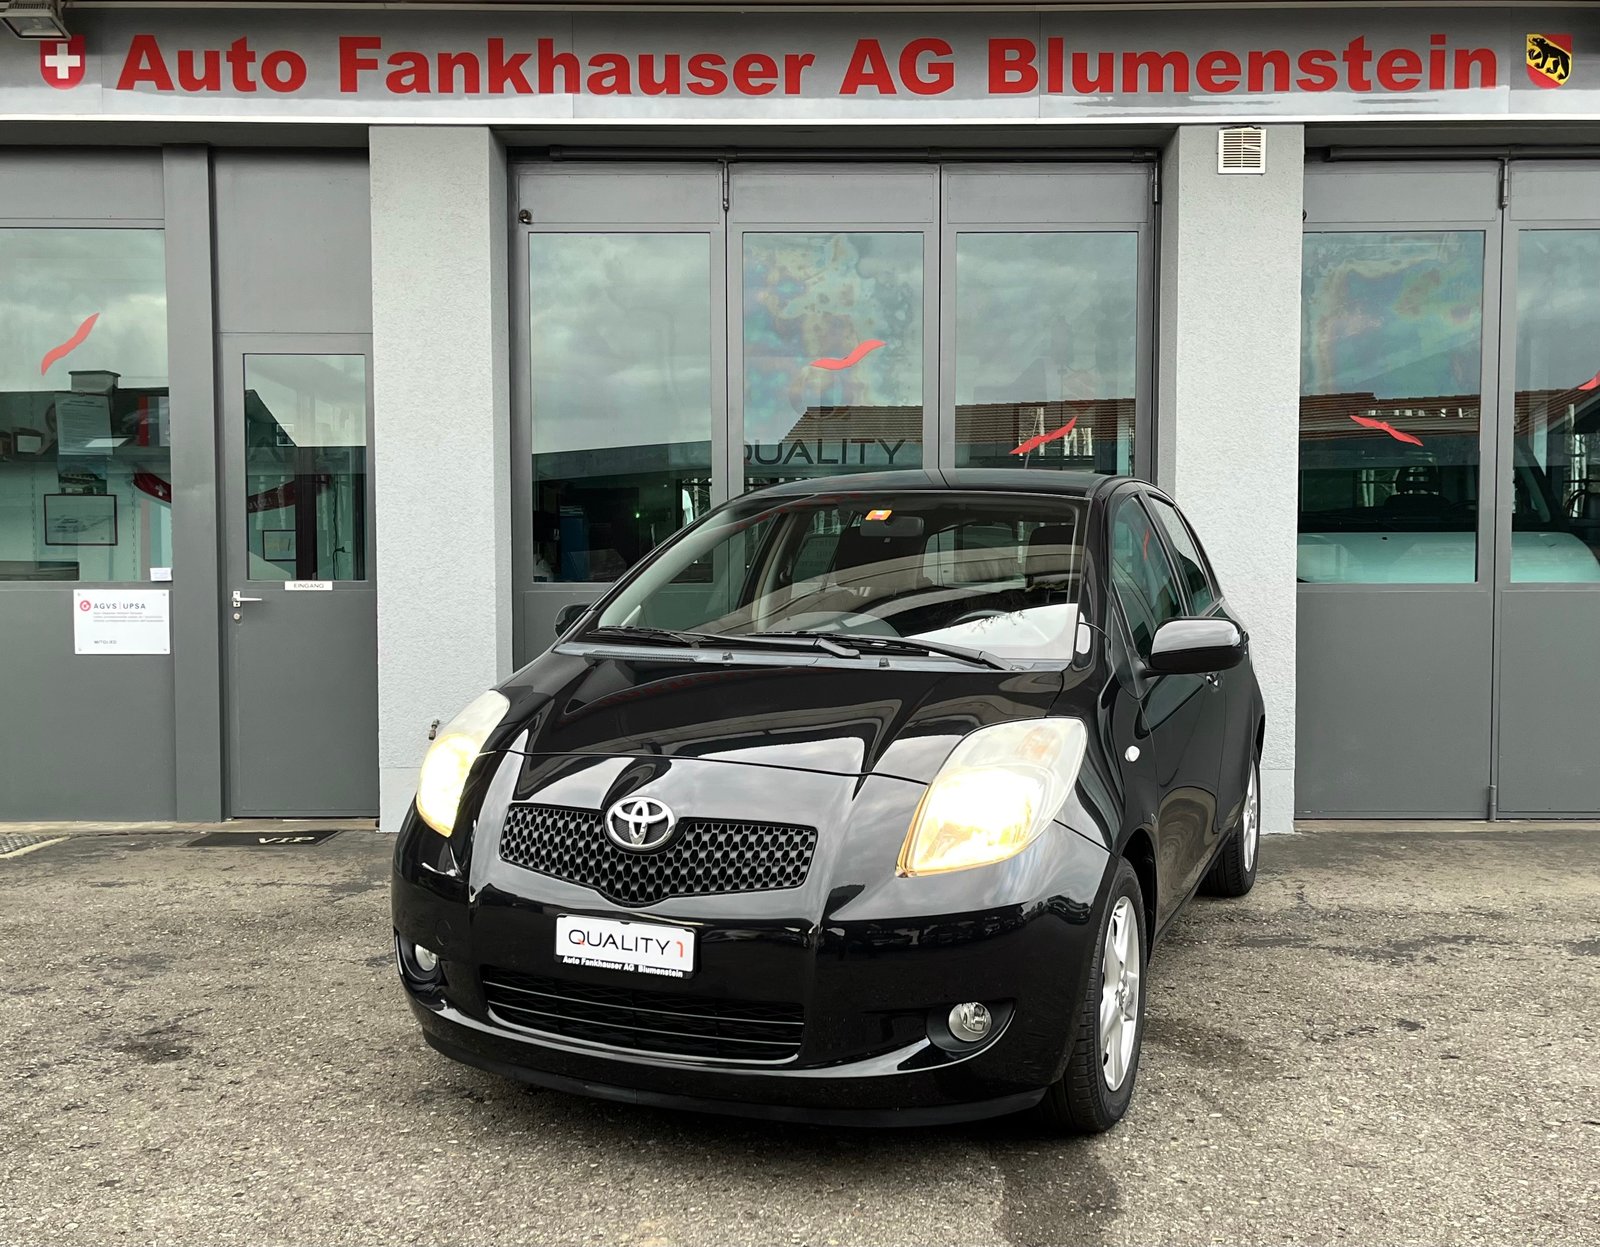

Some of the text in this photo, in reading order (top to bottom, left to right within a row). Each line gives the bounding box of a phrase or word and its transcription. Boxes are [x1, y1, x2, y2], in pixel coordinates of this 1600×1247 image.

[118, 36, 1496, 95] Auto Fankhauser AG Blumenstein
[744, 438, 906, 465] UALITY
[258, 836, 315, 844] VIP
[568, 929, 670, 955] QUALITY
[562, 956, 684, 979] Auto Fankhauser AG Blumenstein
